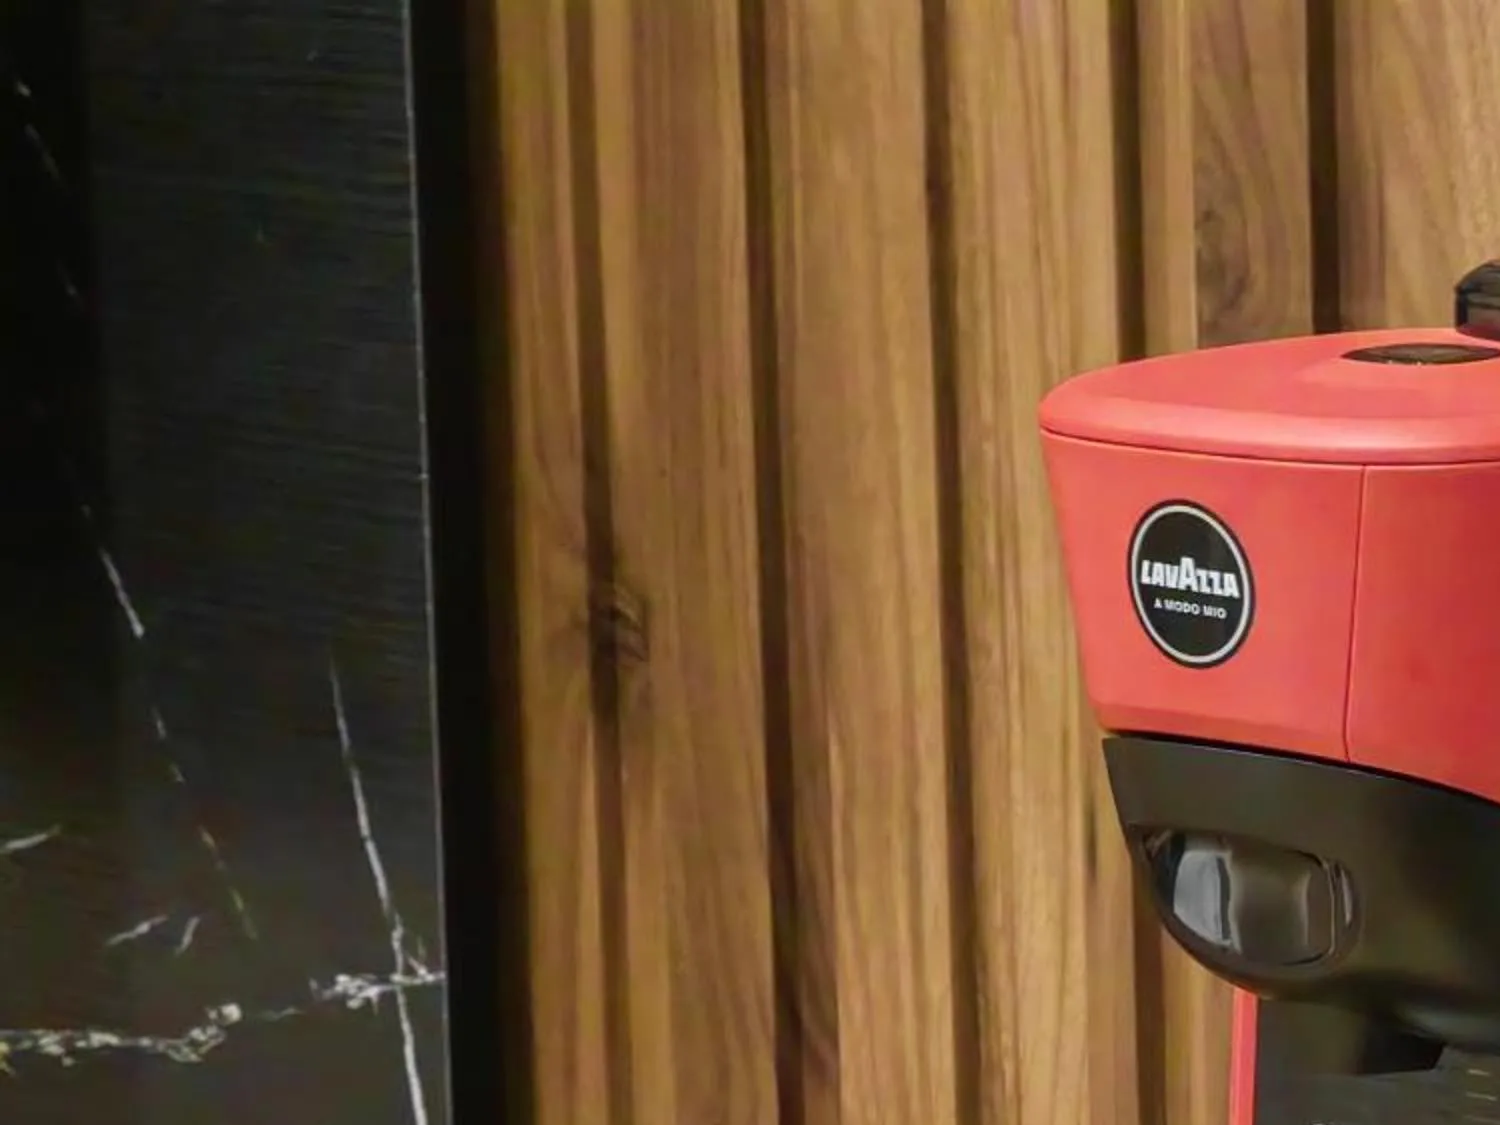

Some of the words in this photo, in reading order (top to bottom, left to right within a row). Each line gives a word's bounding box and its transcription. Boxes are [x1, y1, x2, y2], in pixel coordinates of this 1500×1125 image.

[1140, 556, 1240, 599] LAVAZZA
[1154, 597, 1162, 609] A
[1164, 599, 1200, 615] MODO
[1203, 604, 1228, 619] MIO
